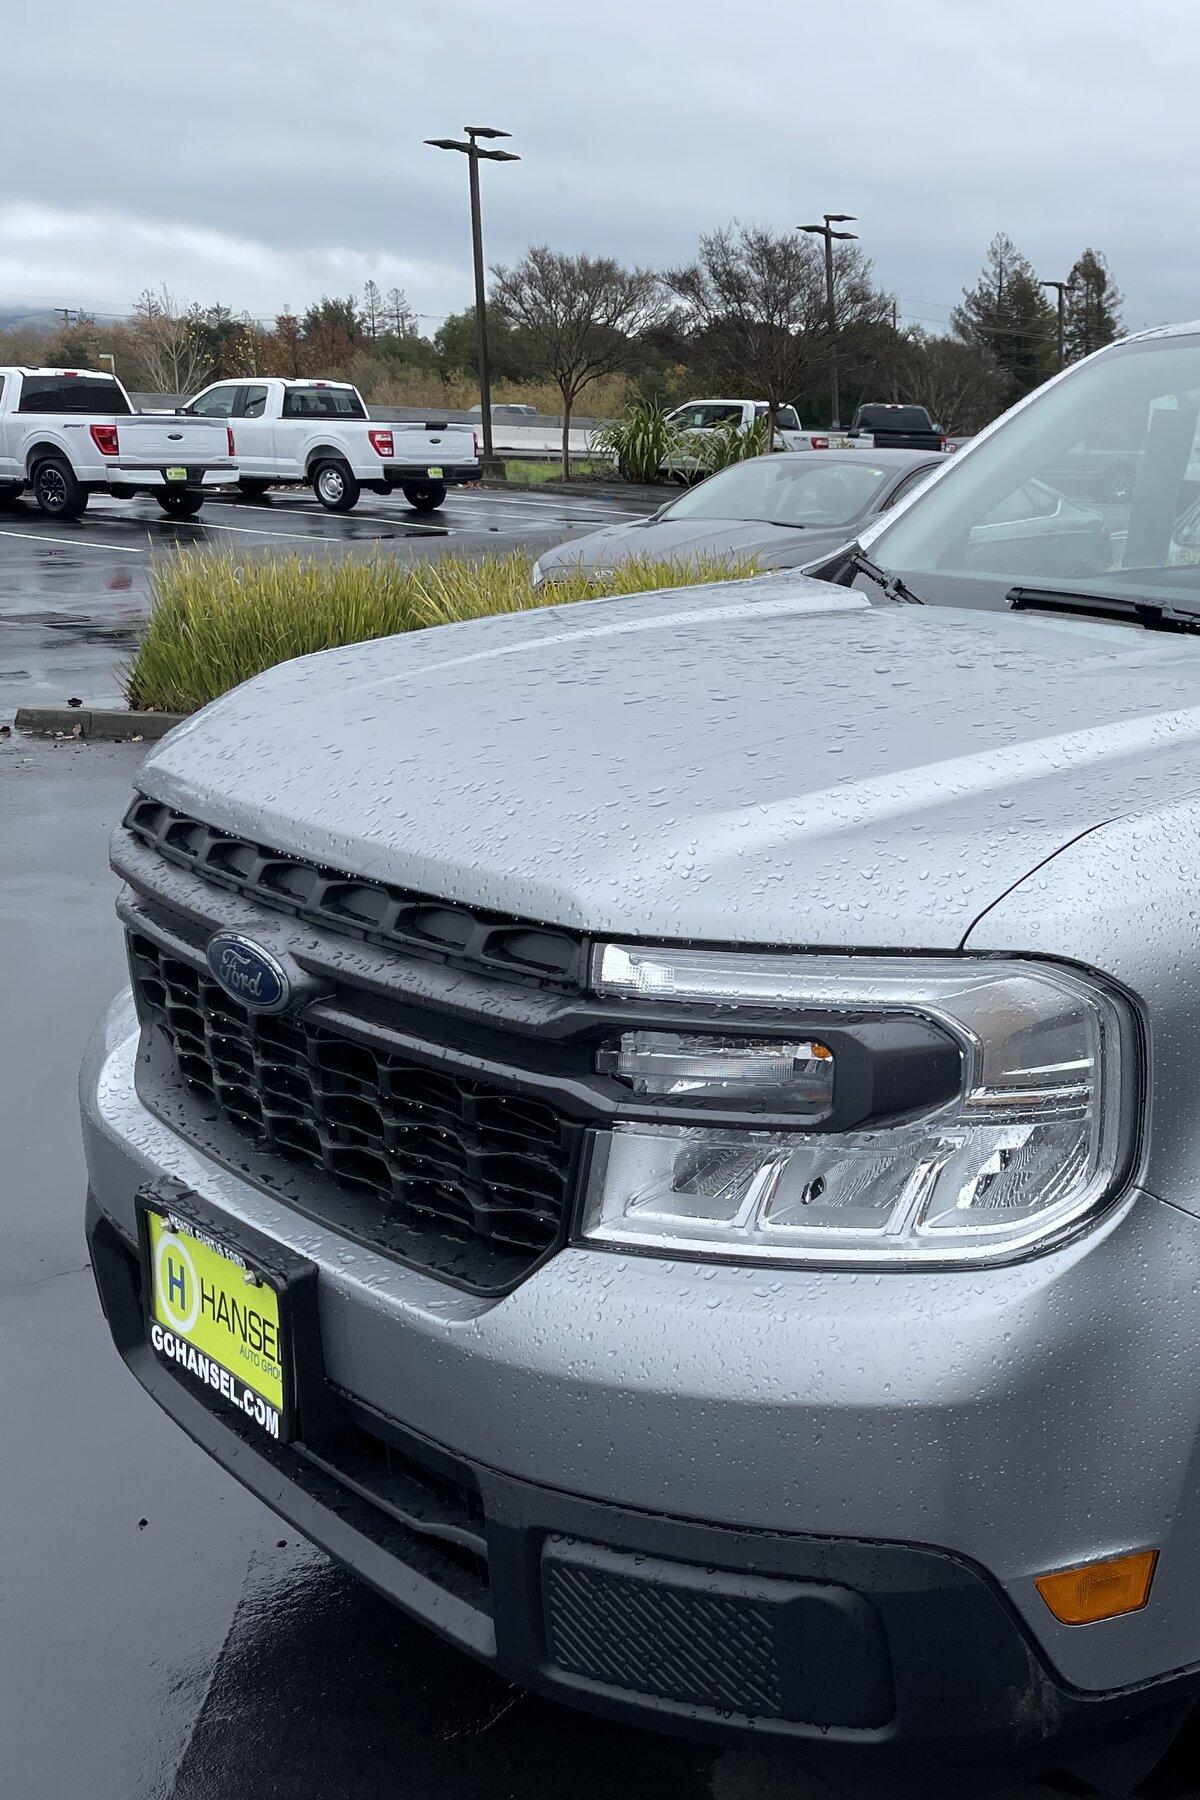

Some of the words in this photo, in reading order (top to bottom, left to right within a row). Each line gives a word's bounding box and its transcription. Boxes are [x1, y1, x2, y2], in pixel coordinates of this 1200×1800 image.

[220, 949, 263, 996] Ford
[240, 1345, 260, 1367] AUTO
[151, 1324, 279, 1439] GOHANSEL.COM
